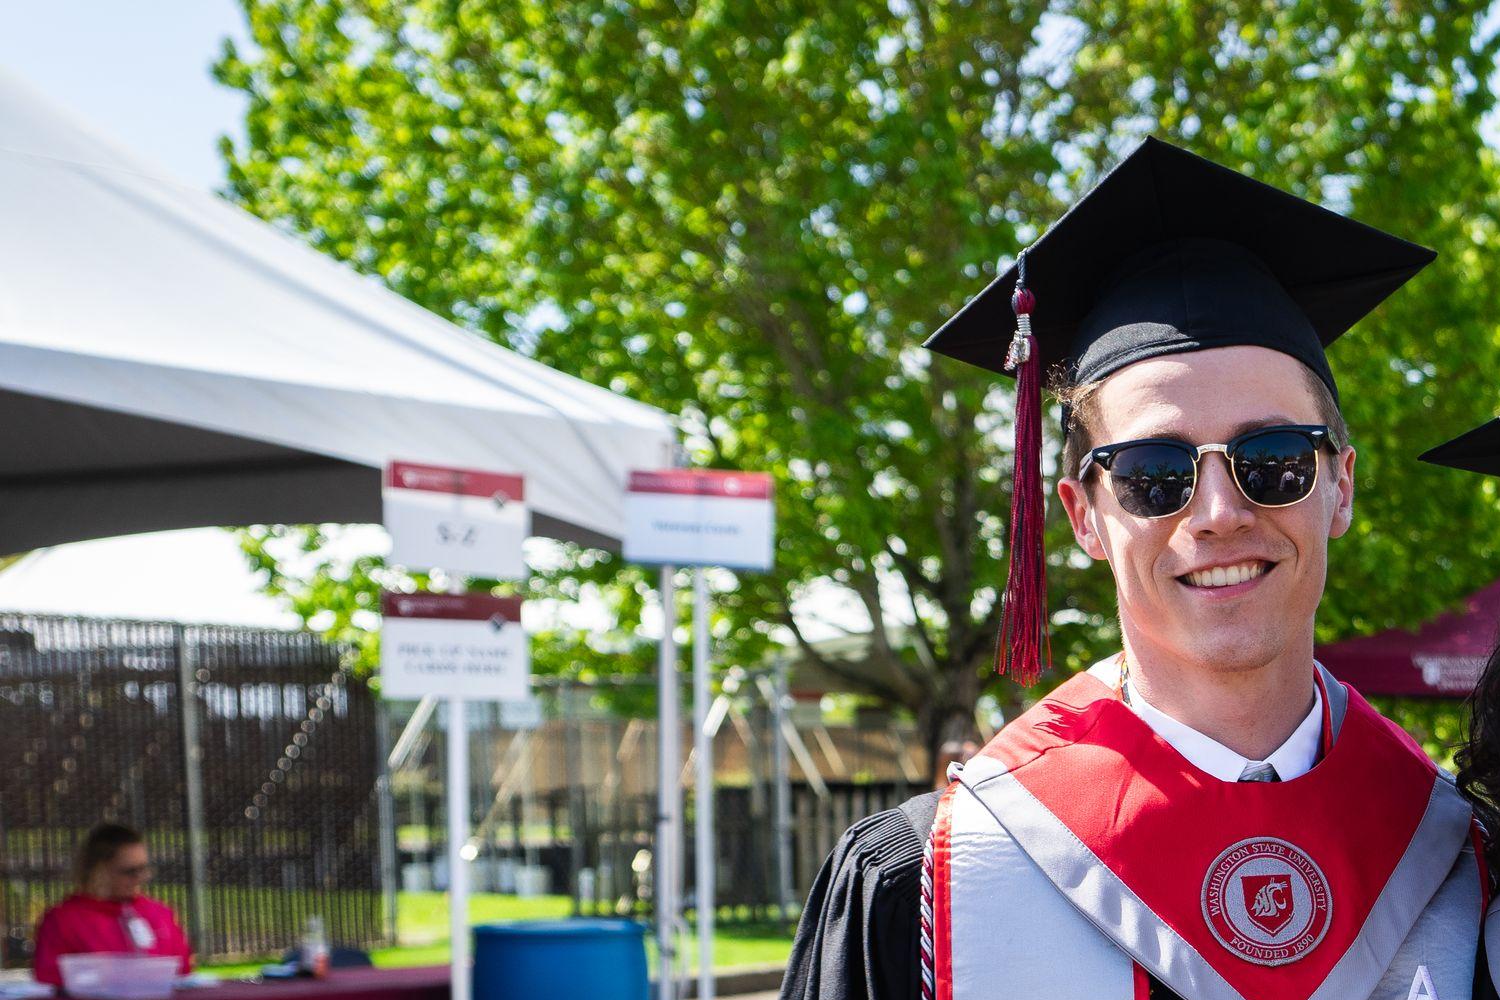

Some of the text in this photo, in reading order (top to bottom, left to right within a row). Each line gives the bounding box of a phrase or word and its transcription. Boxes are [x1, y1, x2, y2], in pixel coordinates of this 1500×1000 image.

[1209, 843, 1327, 916] WASHINGTON STATE UNIVERSITY
[1230, 934, 1314, 959] FOUNDED 1890
